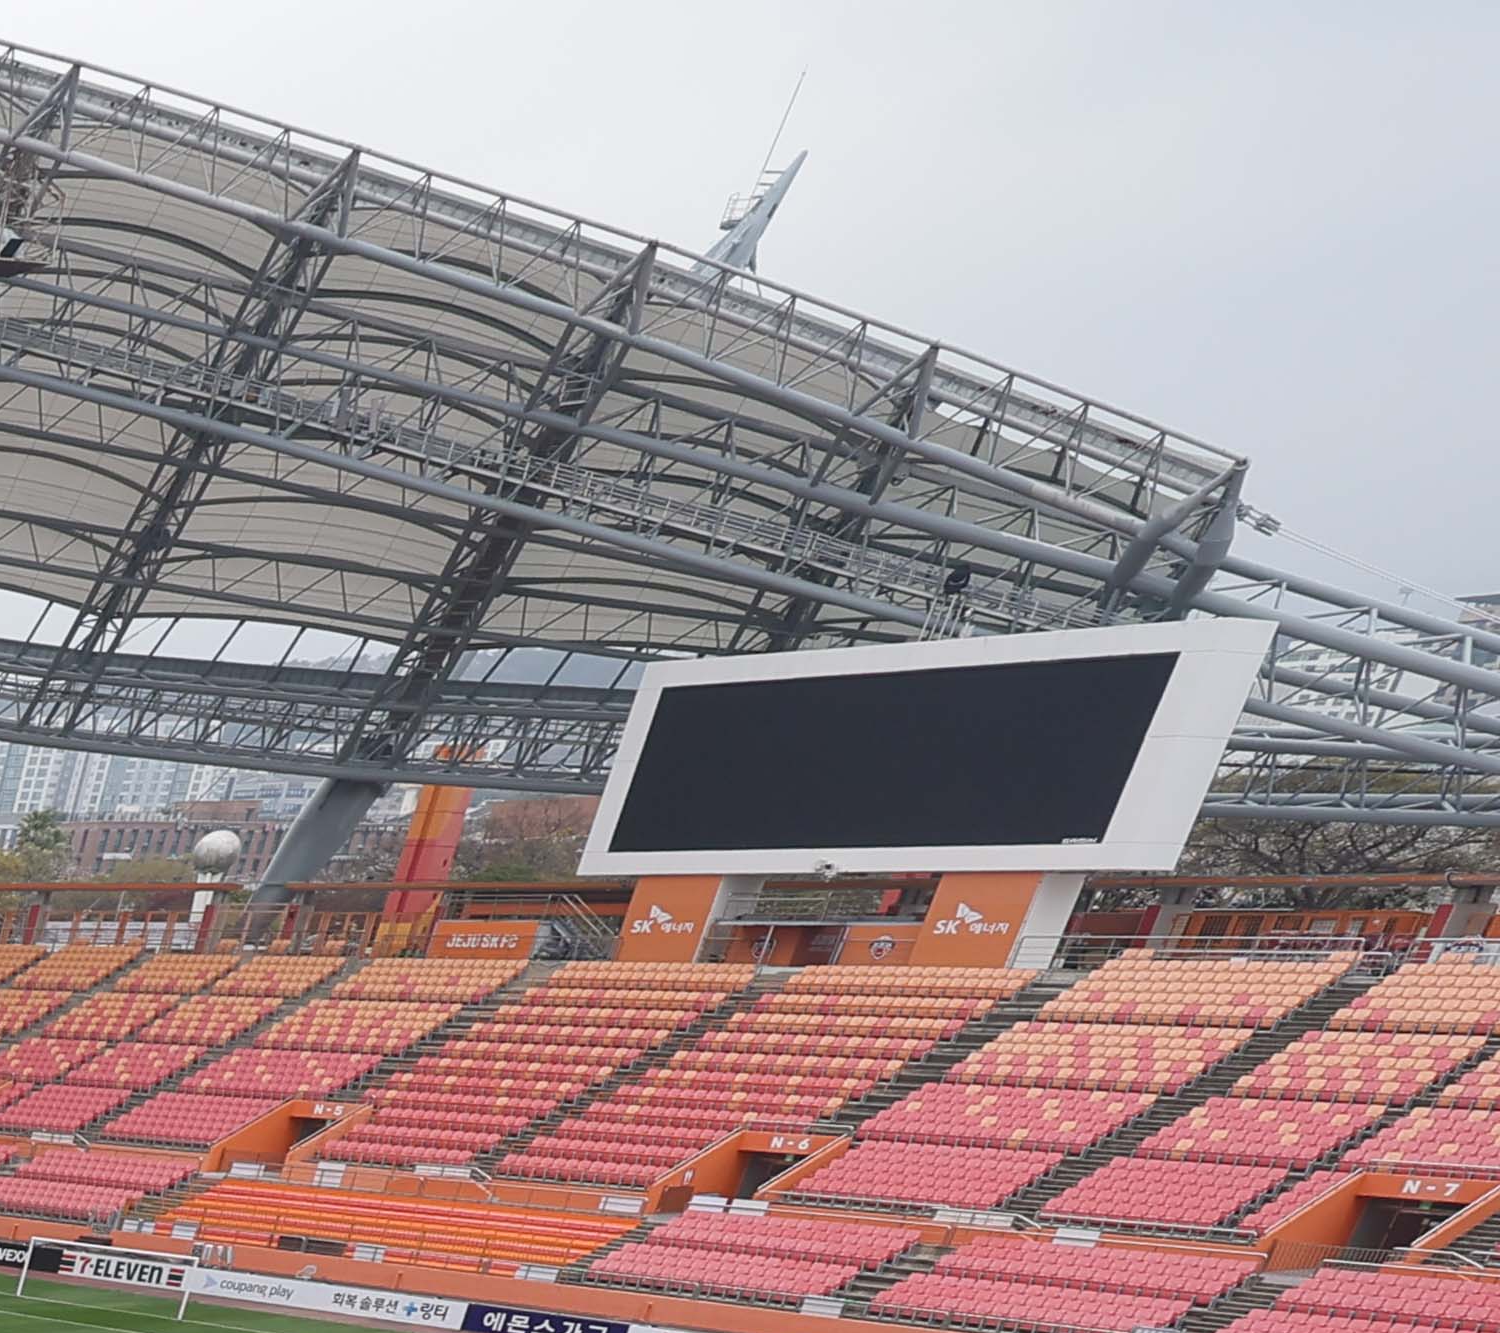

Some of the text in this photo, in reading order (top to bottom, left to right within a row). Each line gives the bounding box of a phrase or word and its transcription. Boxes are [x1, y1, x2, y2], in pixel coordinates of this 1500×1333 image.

[630, 920, 694, 934] SK 에너지
[933, 920, 1011, 934] SK 에너지
[446, 933, 519, 948] JEJU SK FC
[313, 1104, 344, 1117] N-5
[770, 1136, 811, 1150] N-6
[1402, 1180, 1461, 1196] N-7
[220, 1276, 294, 1299] coupang play
[332, 1291, 450, 1321] 회복 솔루션 링티
